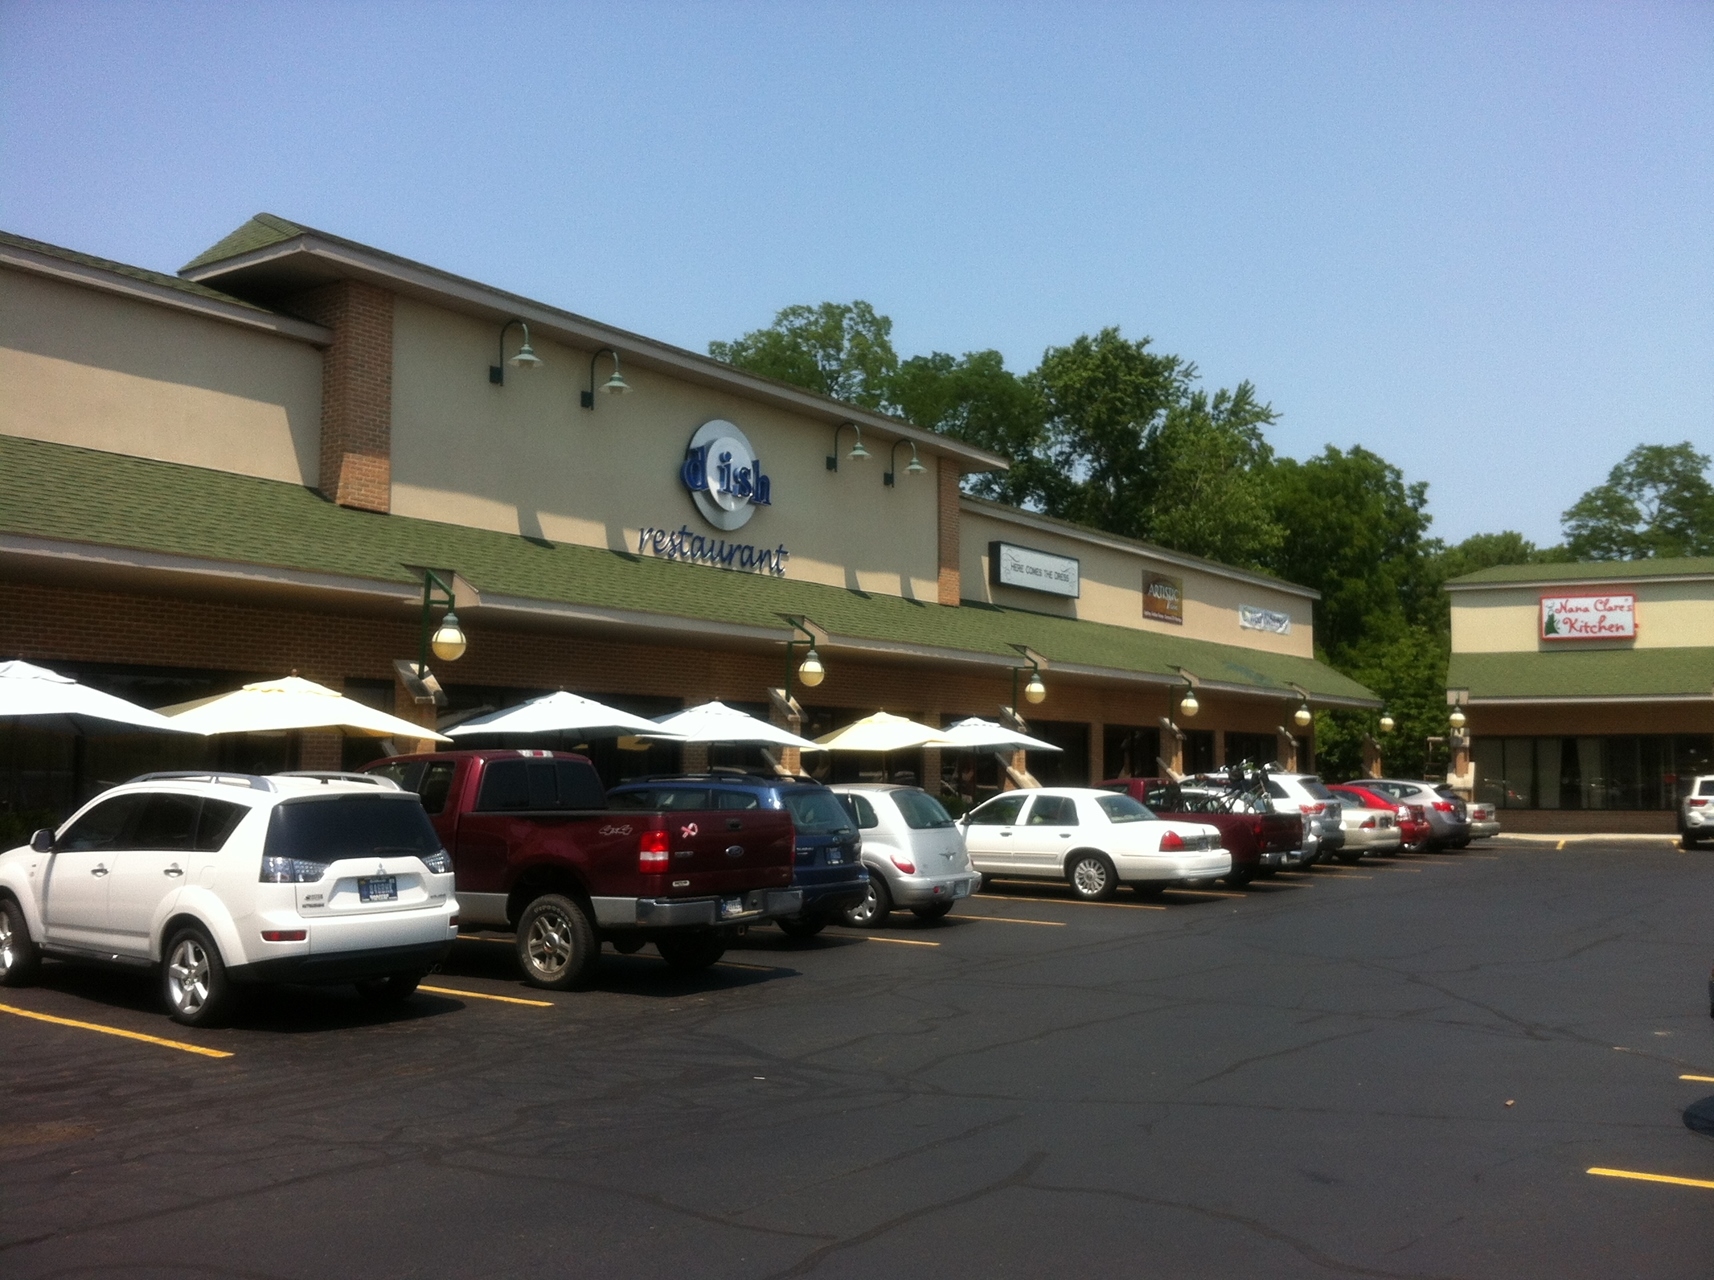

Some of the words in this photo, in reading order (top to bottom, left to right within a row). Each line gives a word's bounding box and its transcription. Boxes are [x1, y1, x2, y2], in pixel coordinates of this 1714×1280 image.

[680, 445, 772, 506] dish
[638, 524, 789, 575] restaurant
[1010, 562, 1024, 573] HERE
[1025, 565, 1042, 577] COMES
[1043, 569, 1053, 579] THE
[1054, 571, 1070, 582] DRESS
[1147, 583, 1179, 602] ARTISTIC
[1555, 599, 1590, 614] Nana
[1593, 597, 1633, 613] Clare's
[1562, 614, 1625, 634] Kitchen
[598, 824, 633, 836] 4x4
